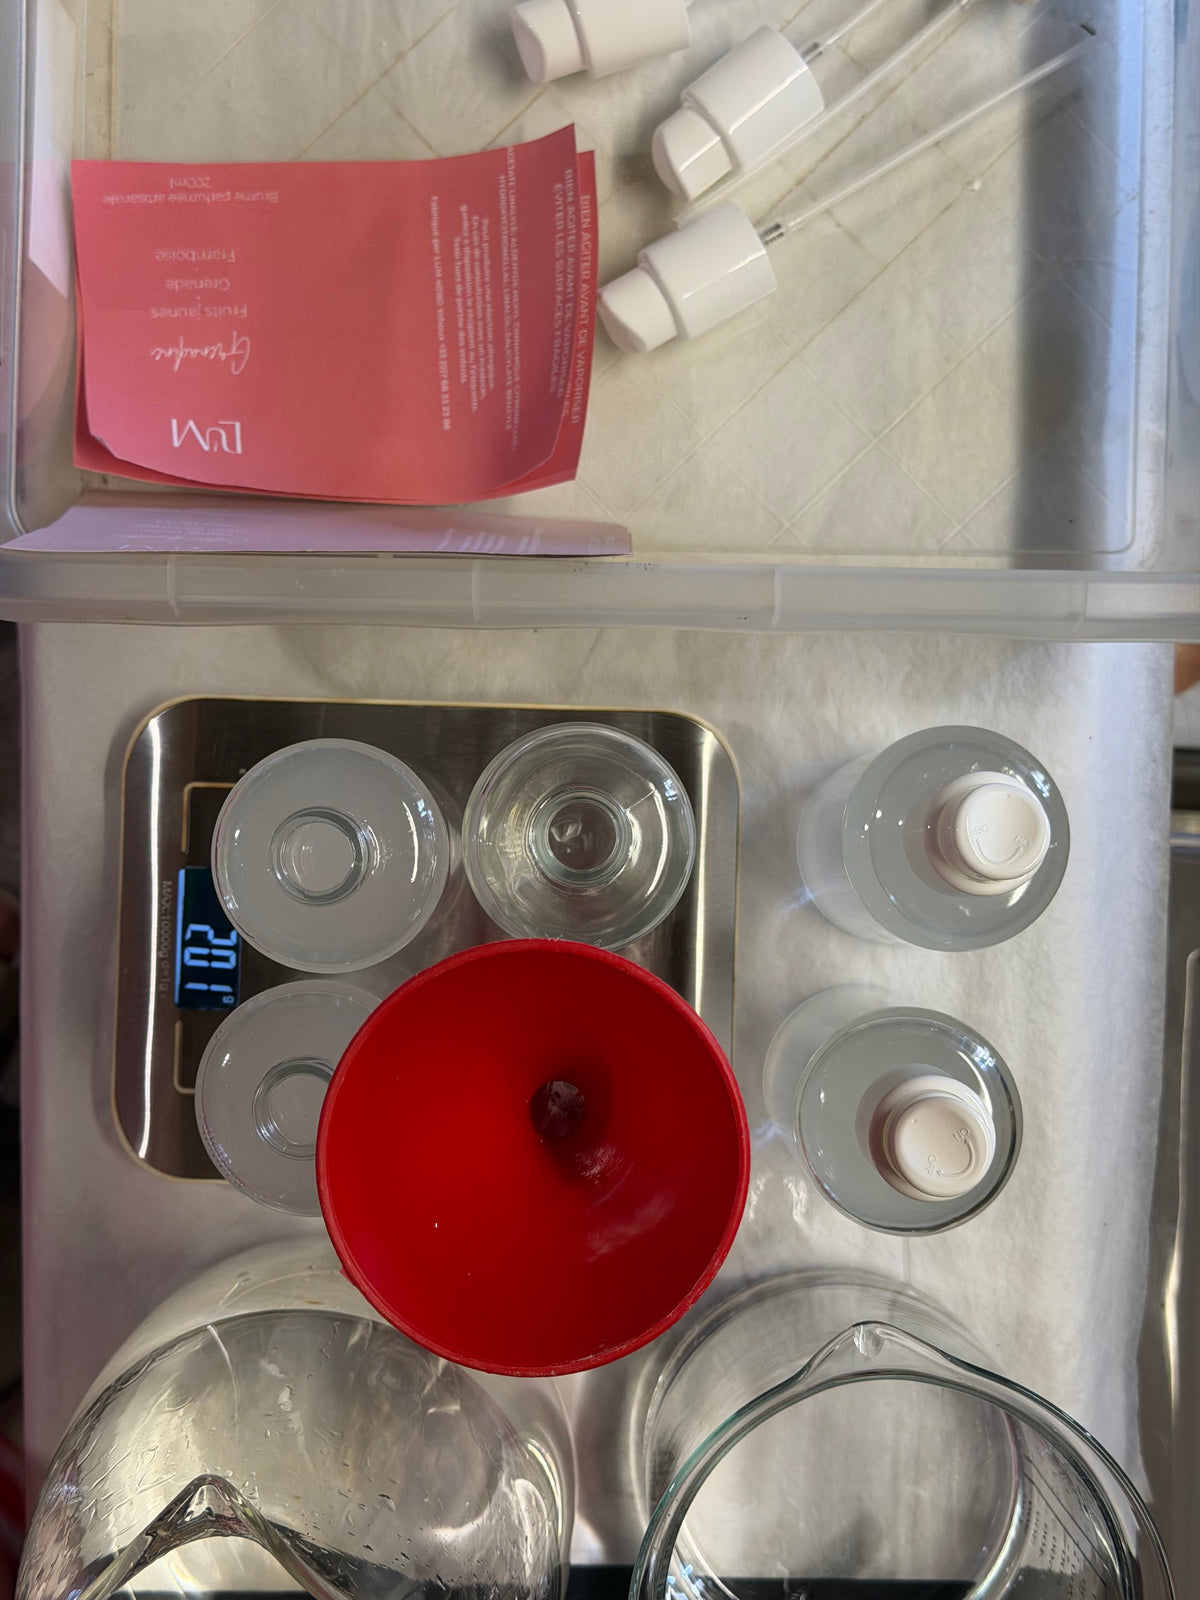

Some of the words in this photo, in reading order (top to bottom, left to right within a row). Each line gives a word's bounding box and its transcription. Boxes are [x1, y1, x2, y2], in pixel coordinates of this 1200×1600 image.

[169, 176, 212, 189] 200ml
[564, 169, 574, 202] BIEN
[103, 193, 166, 207] artisanale
[235, 191, 279, 204] Brume
[580, 195, 592, 228] BIEN
[566, 205, 577, 253] AGITER
[154, 249, 236, 263] Framboise
[554, 233, 565, 258] LES
[580, 232, 591, 280] AGITER
[164, 279, 231, 292] Grenade
[565, 257, 575, 299] AVANT
[553, 260, 564, 328] SURFACES
[579, 283, 591, 326] AVANT
[150, 304, 201, 320] jaunes
[204, 306, 248, 319] Fruits
[564, 302, 574, 321] DE
[150, 330, 251, 375] Grenadine
[578, 329, 588, 347] DE
[549, 330, 562, 394] FRAGILES
[569, 350, 585, 424] VAPORISER
